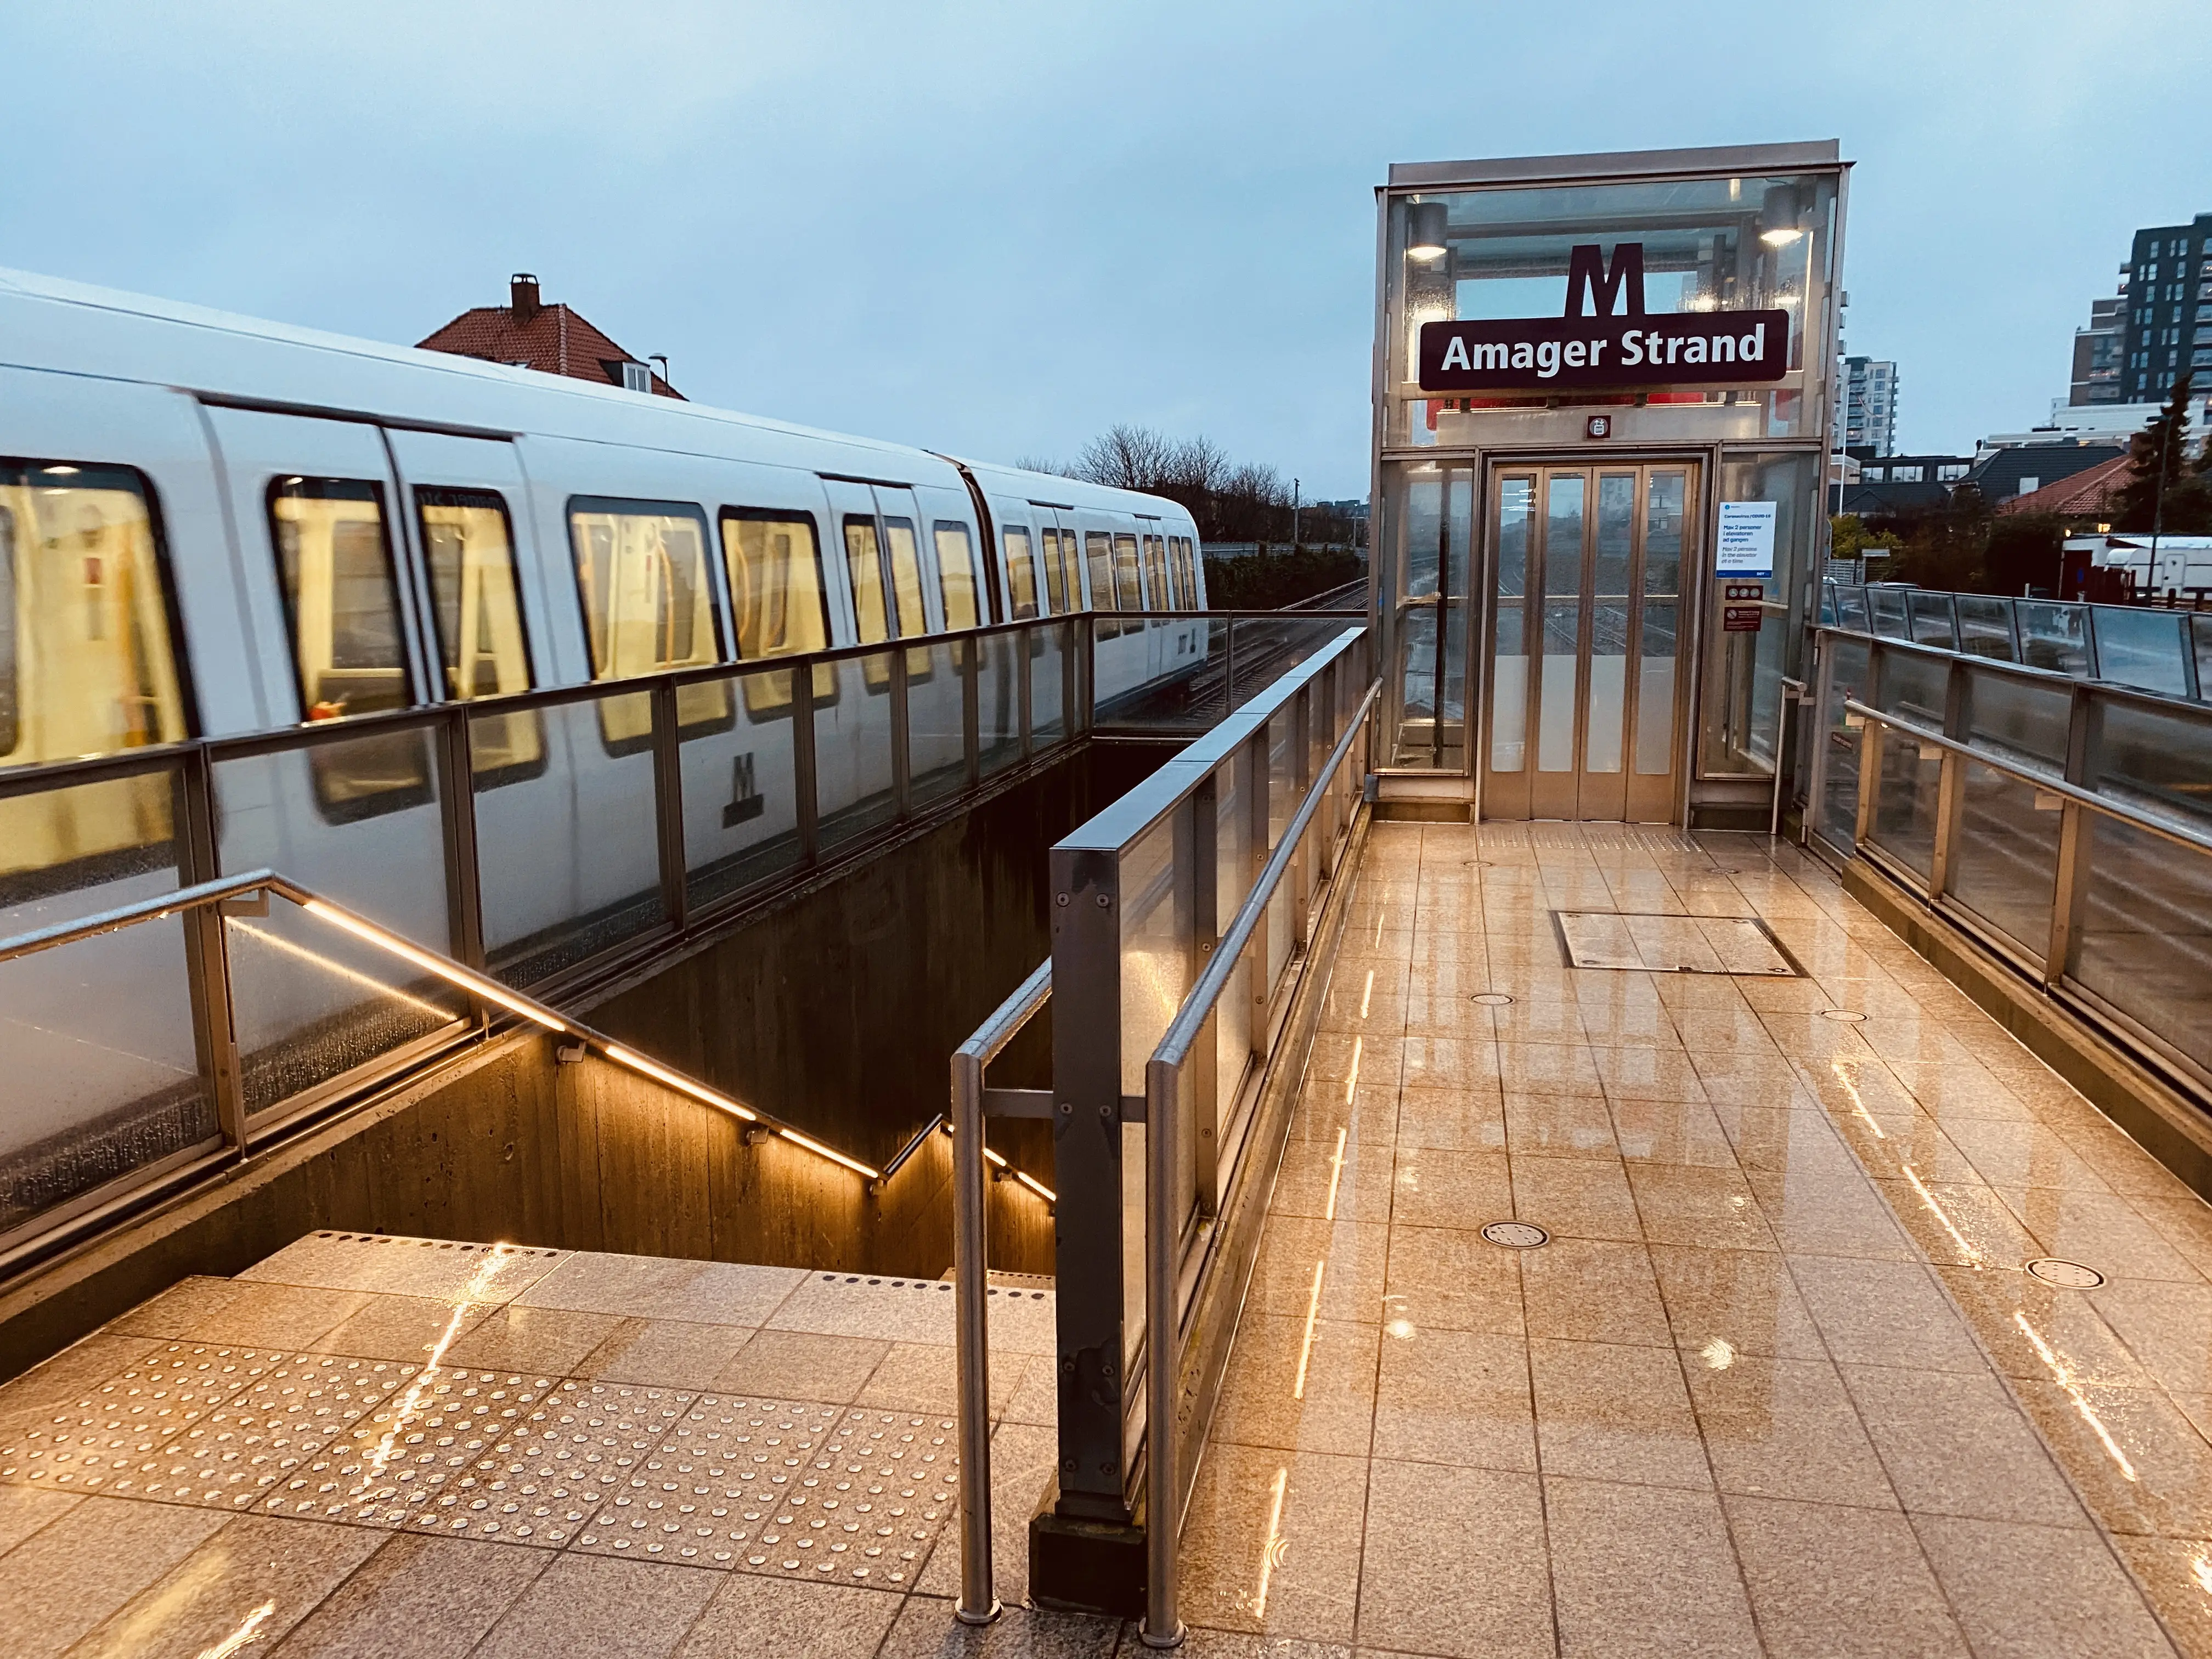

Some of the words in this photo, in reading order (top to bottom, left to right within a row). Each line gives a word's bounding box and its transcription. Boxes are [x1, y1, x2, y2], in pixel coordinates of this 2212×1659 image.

[1564, 242, 1646, 319] M
[1441, 336, 1607, 377] Amager
[1621, 324, 1765, 365] Strand
